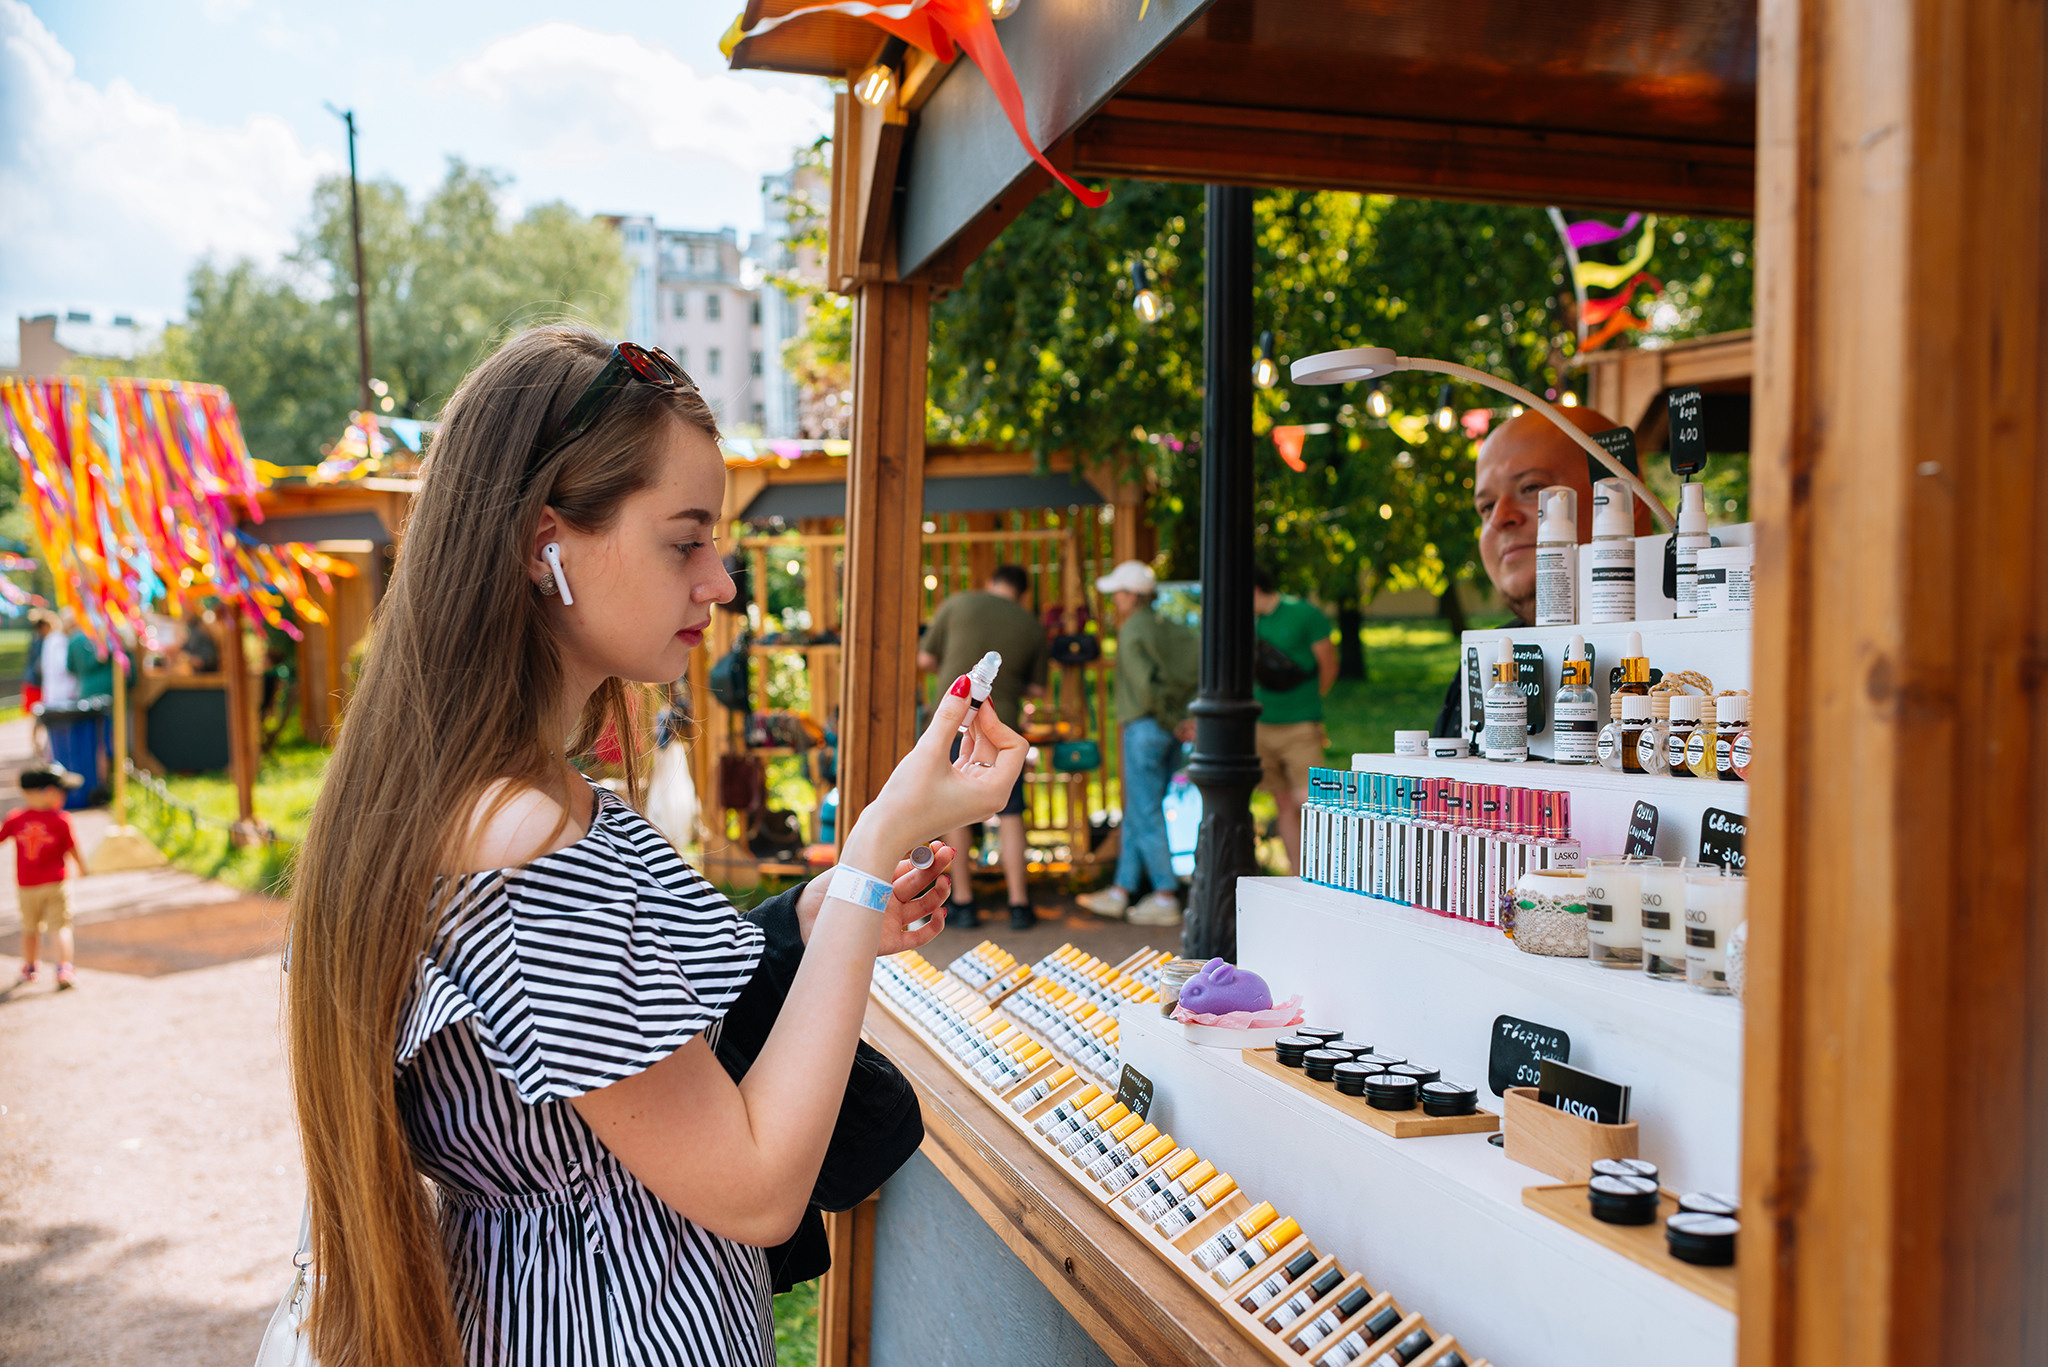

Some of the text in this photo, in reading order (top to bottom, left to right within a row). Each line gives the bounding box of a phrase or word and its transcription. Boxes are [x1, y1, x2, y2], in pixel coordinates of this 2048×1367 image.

[1679, 427, 1698, 443] 400
[1554, 851, 1579, 860] LASKO
[1722, 847, 1746, 868] 300
[1642, 894, 1662, 907] SKO
[1686, 910, 1707, 924] SKO
[1516, 1064, 1541, 1085] 500
[1555, 1094, 1599, 1124] LASKO
